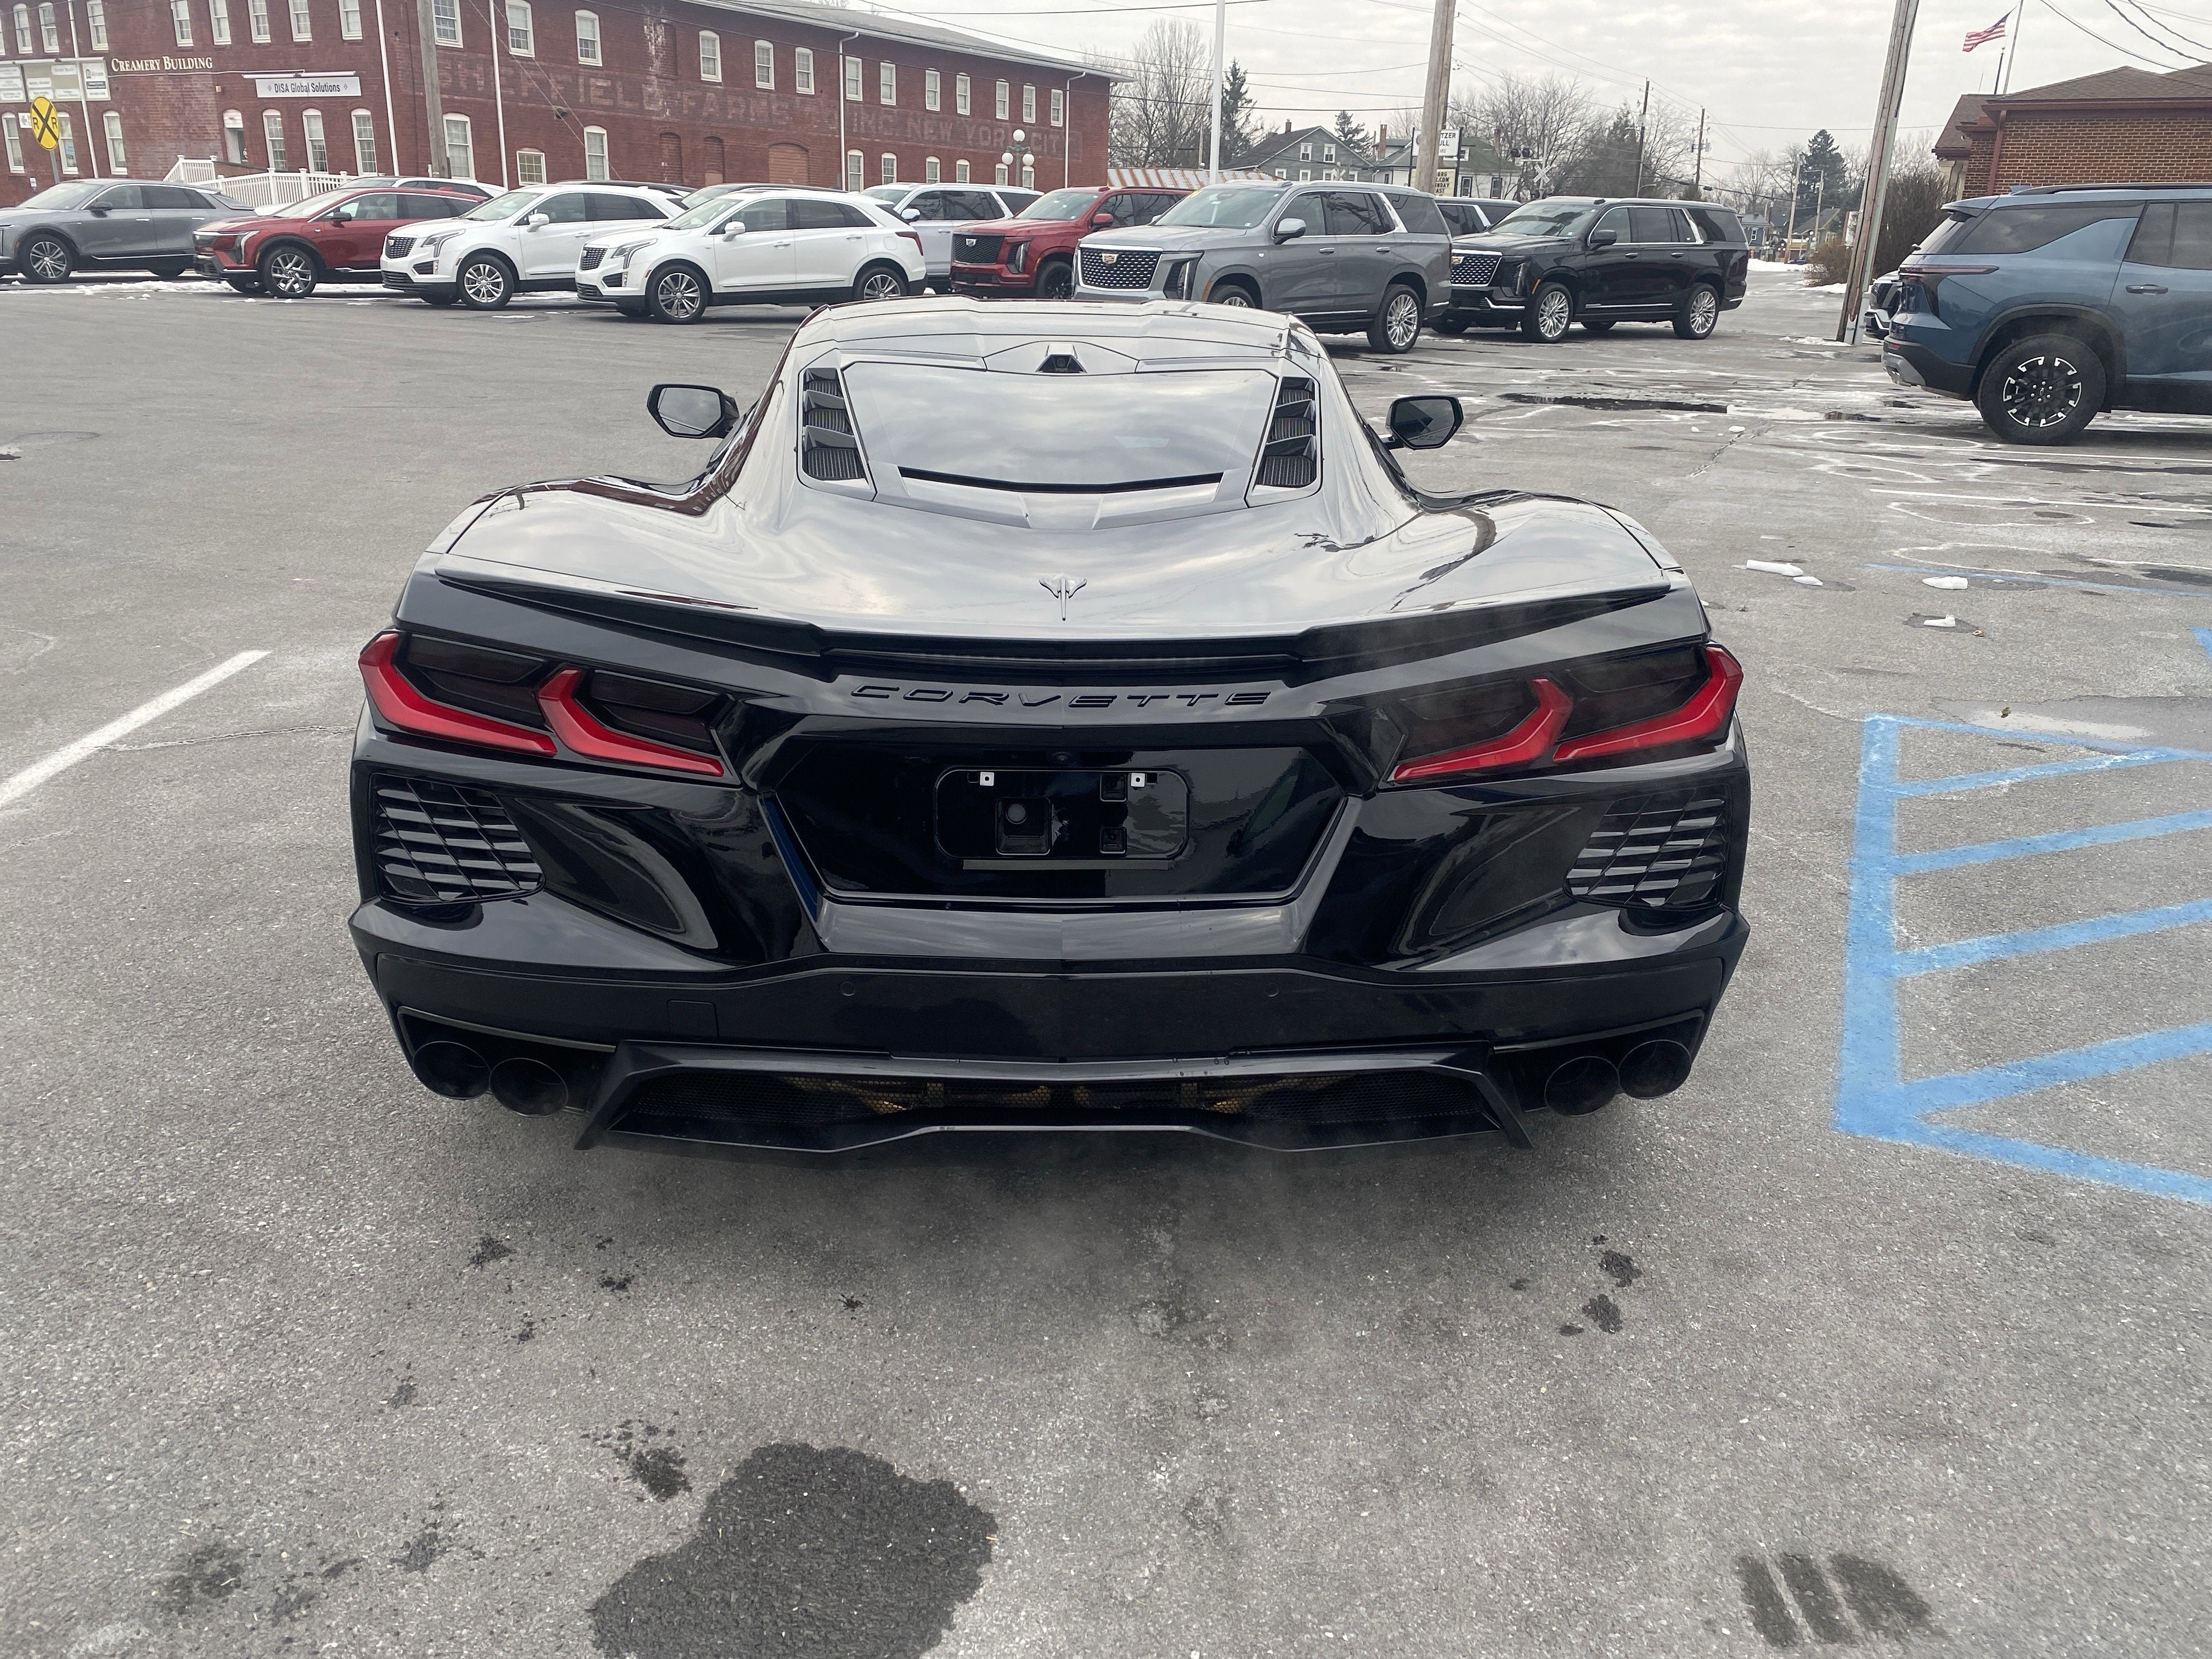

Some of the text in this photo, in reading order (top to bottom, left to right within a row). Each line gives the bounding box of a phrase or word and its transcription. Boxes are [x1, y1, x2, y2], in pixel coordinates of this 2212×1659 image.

[111, 56, 212, 72] CREAMERY BUILDING
[274, 82, 340, 93] DISA Global Solutions
[32, 117, 58, 129] R R
[850, 686, 1271, 708] CORVETTE
